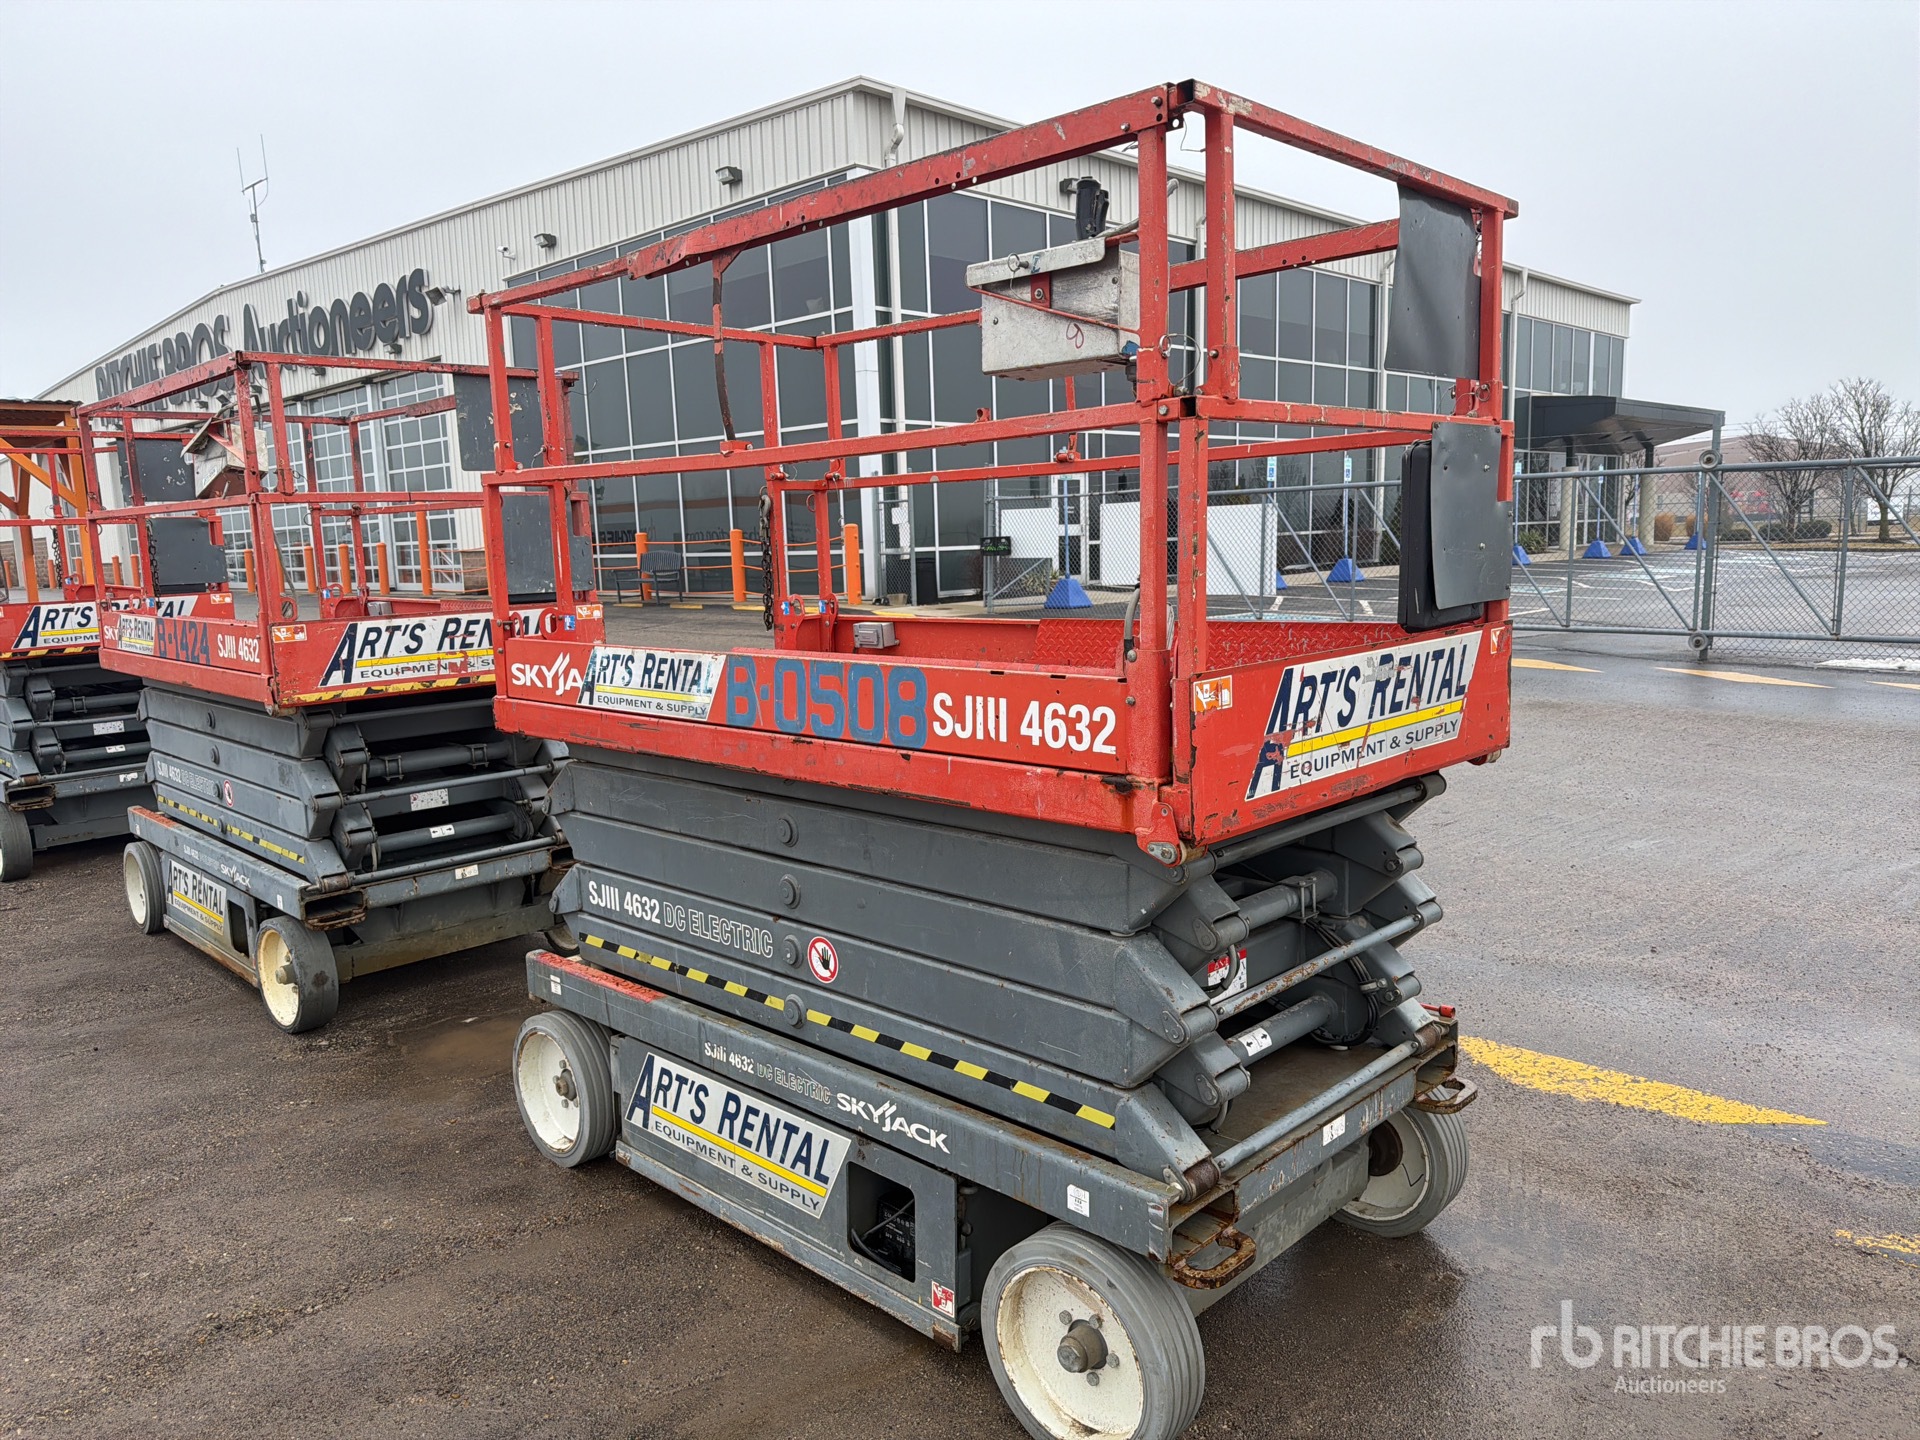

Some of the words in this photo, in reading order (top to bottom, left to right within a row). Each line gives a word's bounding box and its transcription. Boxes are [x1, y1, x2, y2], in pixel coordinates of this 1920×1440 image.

[243, 268, 433, 386] Auctioneers
[13, 606, 93, 648] ART'S
[44, 634, 100, 644] EQUIPME
[238, 636, 261, 663] 4632
[319, 622, 425, 686] ART'S
[578, 650, 635, 705] ART'S
[640, 653, 713, 695] RENTAL
[597, 694, 653, 710] EQUIPMENT
[655, 702, 664, 711] &
[666, 703, 707, 716] SUPPLY
[1020, 700, 1117, 755] 4632
[1246, 666, 1361, 800] ART'S
[1368, 644, 1468, 720] RENTAL
[1290, 740, 1386, 780] EQUIPMENT
[1389, 736, 1401, 750] &
[1405, 719, 1459, 744] SUPPLY
[167, 860, 189, 904] ART'S
[192, 873, 224, 916] RENTAL
[588, 881, 620, 912] SJIII
[624, 890, 661, 924] 4632
[663, 901, 686, 932] DC
[688, 909, 774, 958] ELECTRIC
[728, 1050, 755, 1075] 4632
[774, 1067, 832, 1105] ELECTRIC
[626, 1054, 710, 1130] ART'S
[717, 1090, 831, 1185] RENTAL
[836, 1092, 951, 1155] SKYJACK
[654, 1120, 736, 1169] EQUIPMENT
[740, 1163, 754, 1178] &
[757, 1171, 821, 1212] SUPPLY
